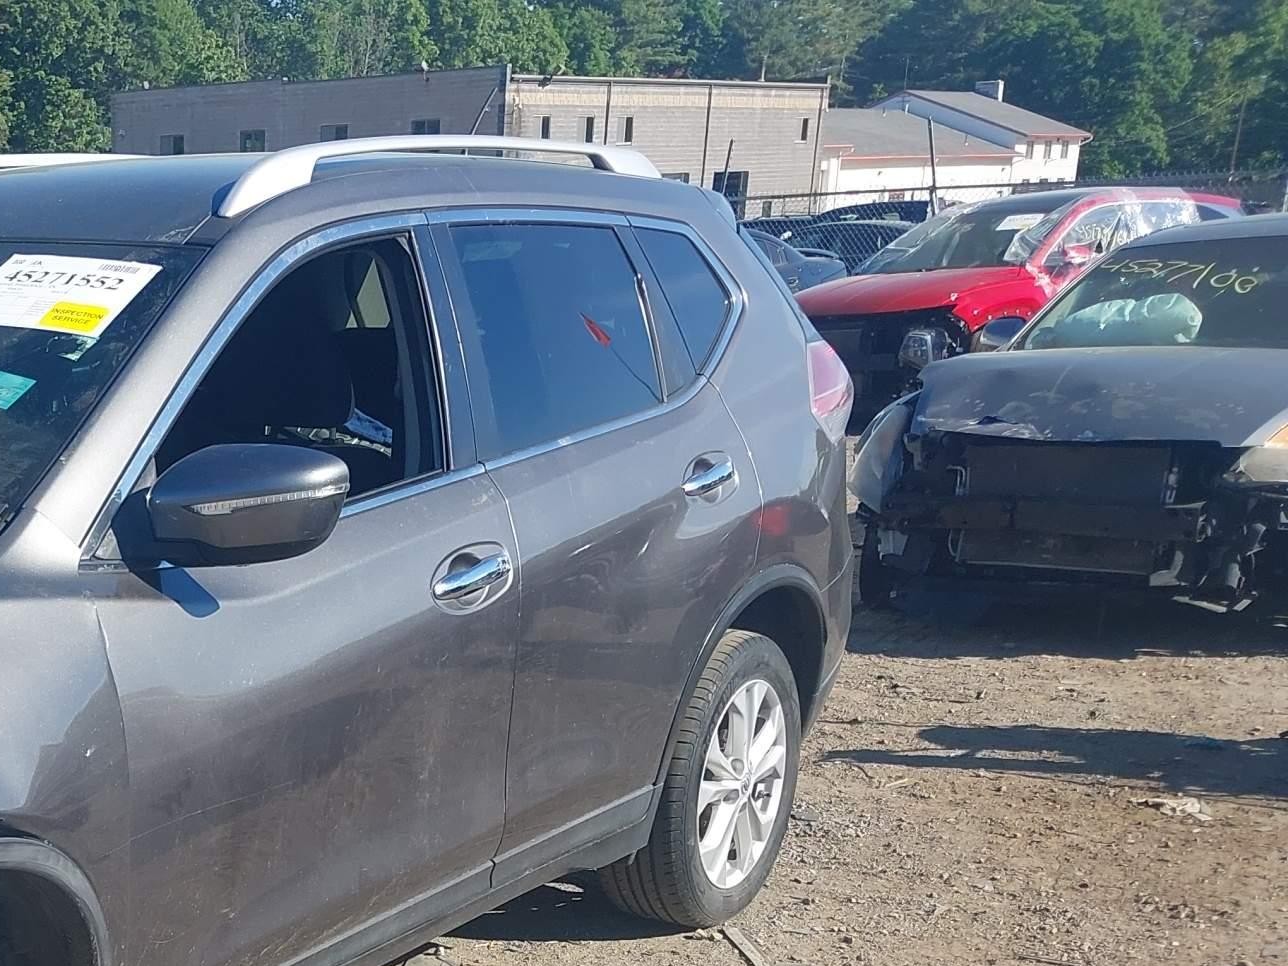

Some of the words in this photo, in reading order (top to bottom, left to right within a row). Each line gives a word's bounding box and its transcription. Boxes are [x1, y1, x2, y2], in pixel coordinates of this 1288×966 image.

[5, 269, 125, 290] 45271552
[50, 307, 105, 321] INSPECTION
[51, 314, 92, 326] SERVICE
